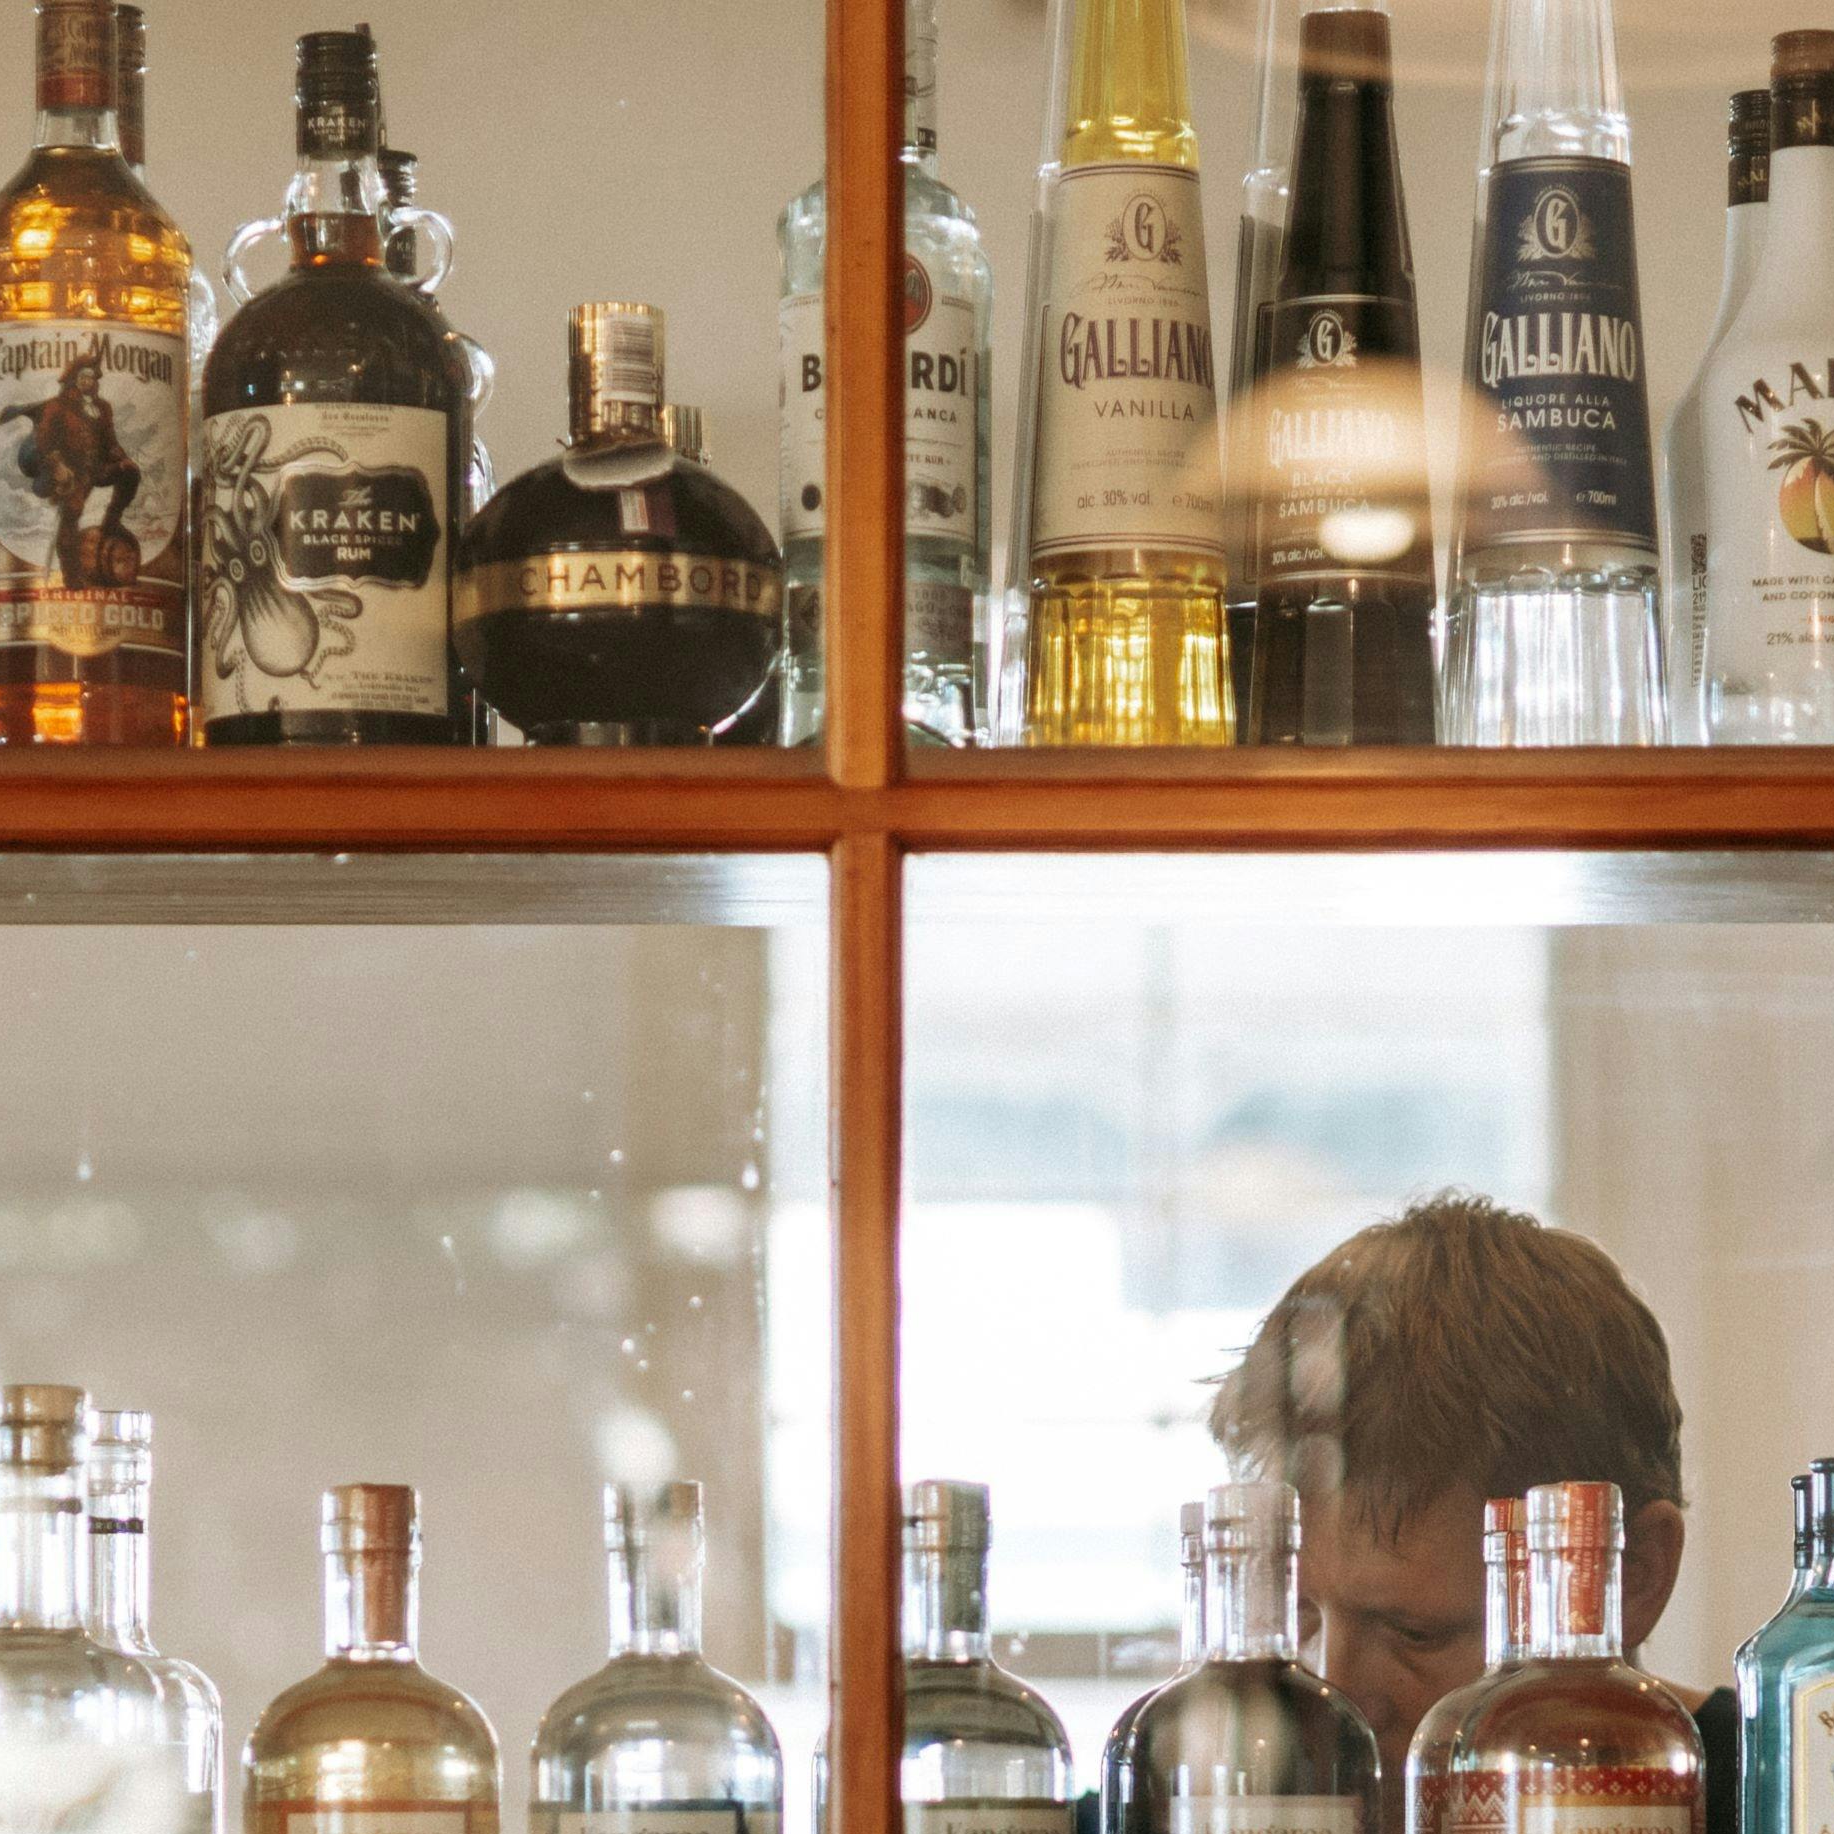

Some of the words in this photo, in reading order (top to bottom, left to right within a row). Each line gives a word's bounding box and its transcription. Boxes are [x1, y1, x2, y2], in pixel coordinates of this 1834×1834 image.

[307, 117, 366, 129] KRAKEN
[81, 331, 173, 386] Morgan
[1060, 311, 1214, 390] GALLIANO
[1481, 311, 1636, 388] GALLIANO
[801, 350, 966, 396] BRDÍ
[1094, 400, 1195, 422] VANILLA
[1502, 394, 1566, 409] LIQUORE
[1575, 394, 1610, 407] ALLA
[1497, 408, 1616, 432] SAMBUCA
[1292, 469, 1353, 487] BLACK
[1279, 499, 1369, 519] SAMBUCA
[289, 510, 416, 532] KRAKEN
[303, 534, 348, 545] BLACK
[337, 546, 371, 561] RUM
[518, 561, 763, 601] CHAMBORD
[1752, 576, 1785, 588] MADE
[1787, 576, 1819, 586] WITH
[38, 590, 130, 601] ORIGINAL
[1762, 591, 1787, 603] AND
[104, 604, 164, 631] GOLD
[1767, 632, 1794, 646] 21%
